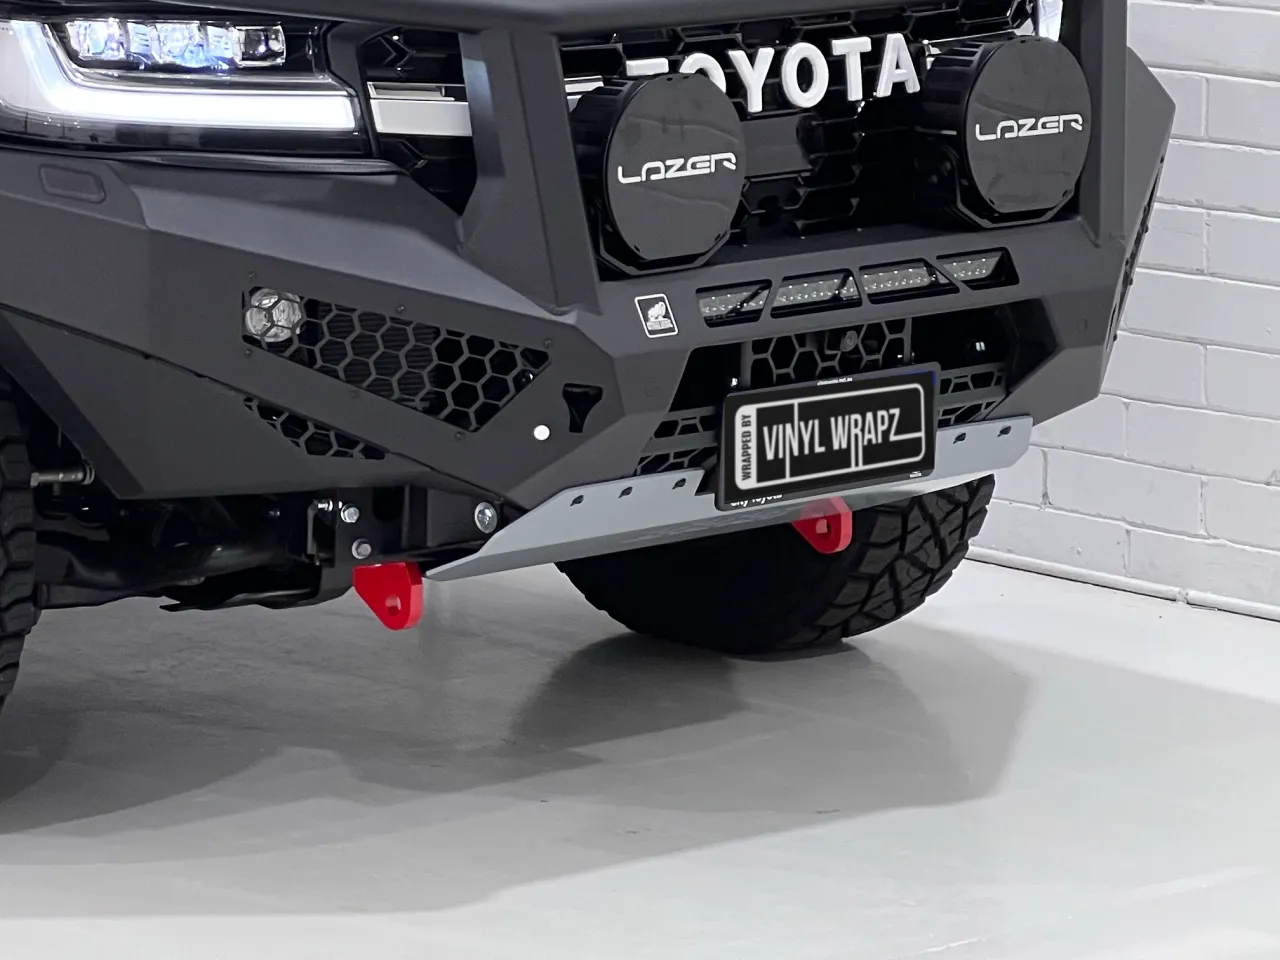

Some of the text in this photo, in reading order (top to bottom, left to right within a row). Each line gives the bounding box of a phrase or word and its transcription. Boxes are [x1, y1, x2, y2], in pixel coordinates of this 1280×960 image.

[975, 113, 1083, 141] LAZER
[617, 152, 737, 184] LAZER
[741, 414, 752, 481] WRAPPED BY
[763, 408, 902, 462] VINYL WRAPZ
